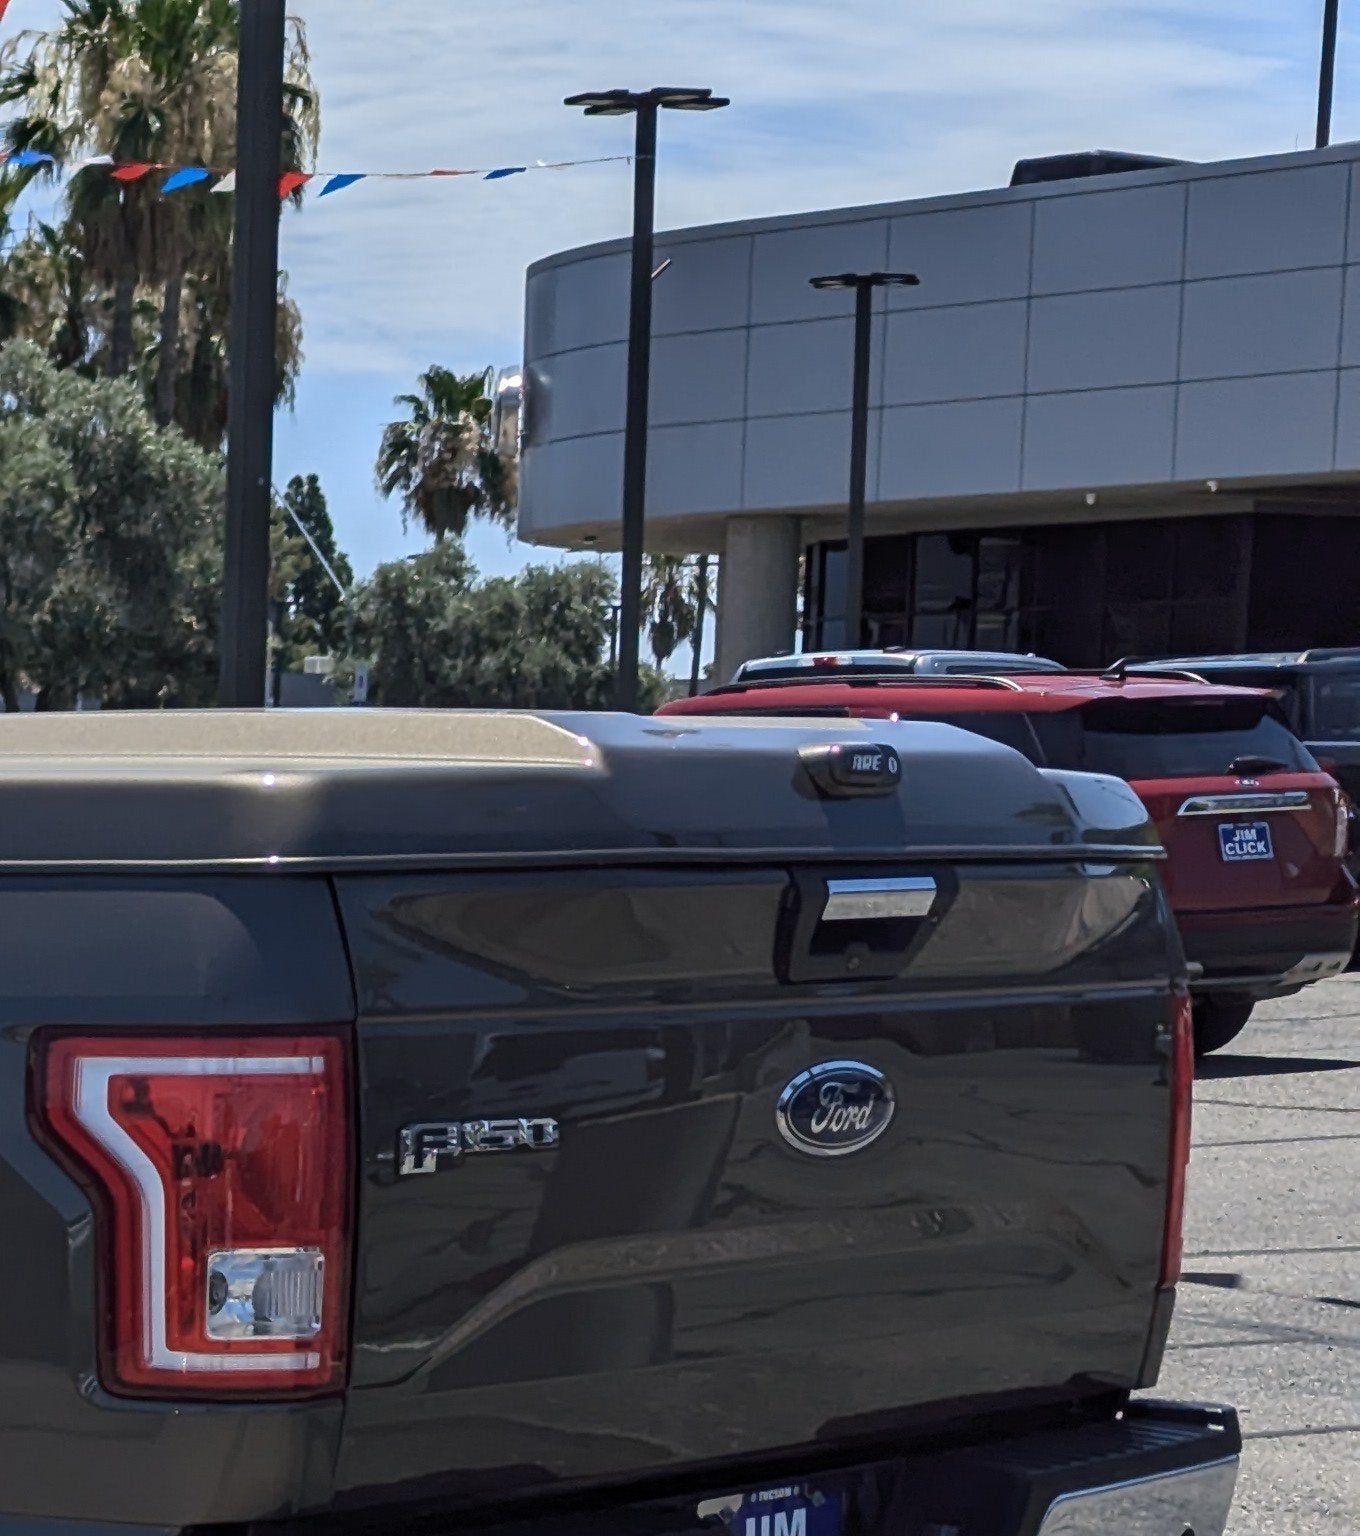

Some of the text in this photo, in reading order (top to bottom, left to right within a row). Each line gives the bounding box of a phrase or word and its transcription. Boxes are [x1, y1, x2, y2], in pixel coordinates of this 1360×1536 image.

[1231, 828, 1257, 841] JIM
[1225, 841, 1267, 856] CLICK
[810, 1081, 872, 1134] Ford
